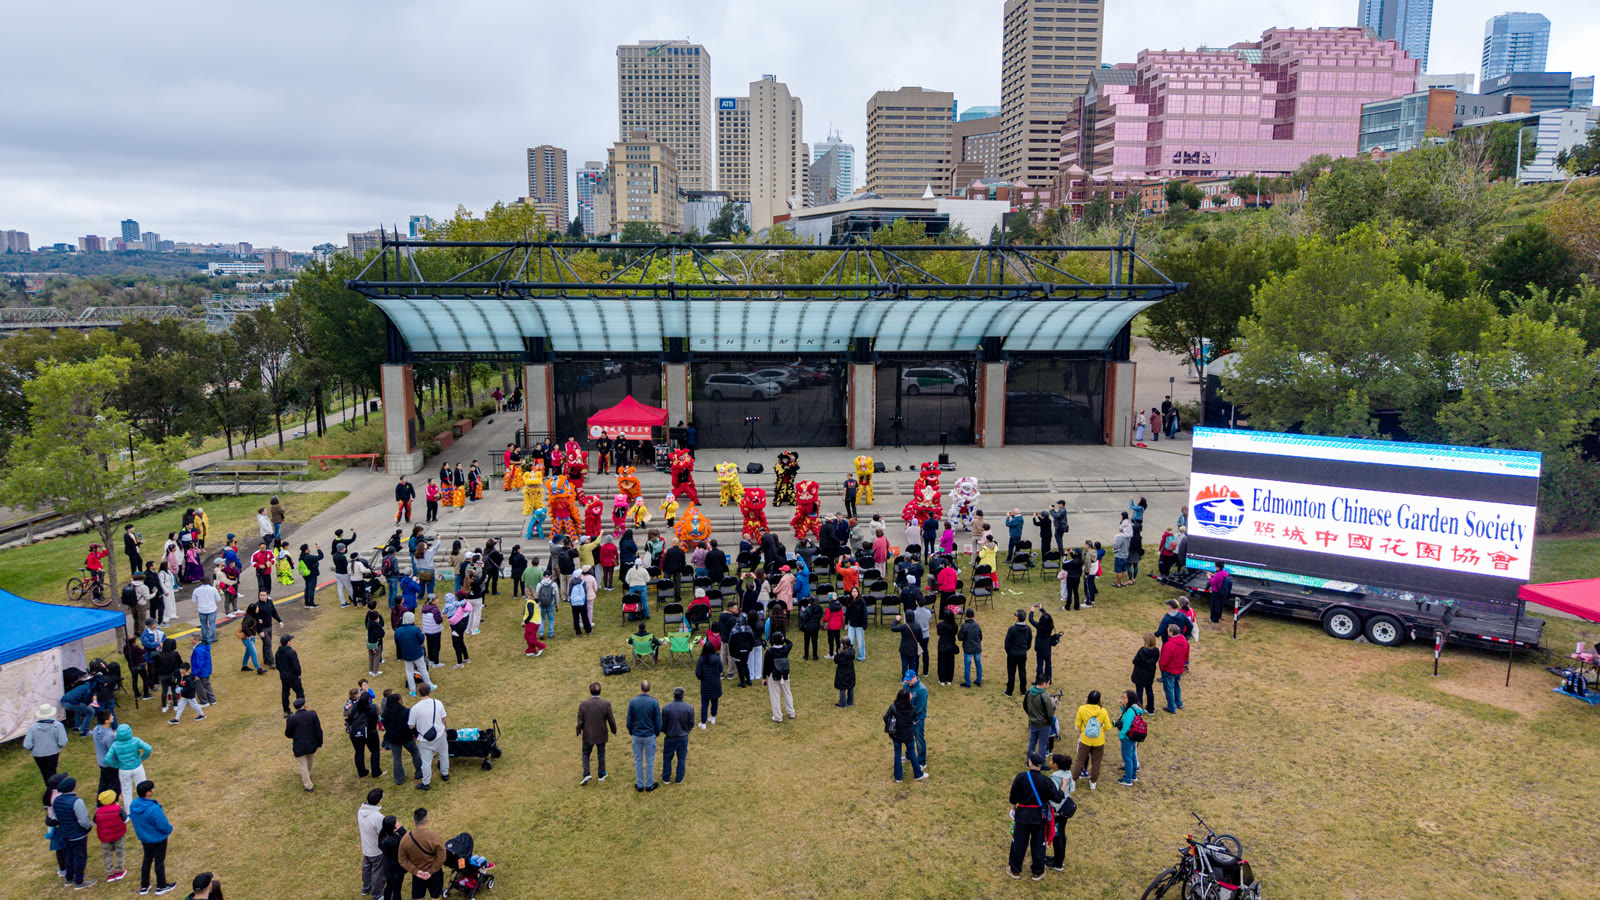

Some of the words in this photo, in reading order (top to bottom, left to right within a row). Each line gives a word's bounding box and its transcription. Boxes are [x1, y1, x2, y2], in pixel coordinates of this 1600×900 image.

[667, 47, 700, 56] TELUS
[1252, 487, 1326, 520] Edmonton
[1332, 496, 1392, 527] Chinese
[1397, 503, 1459, 535] Garden
[1464, 510, 1527, 550] Society
